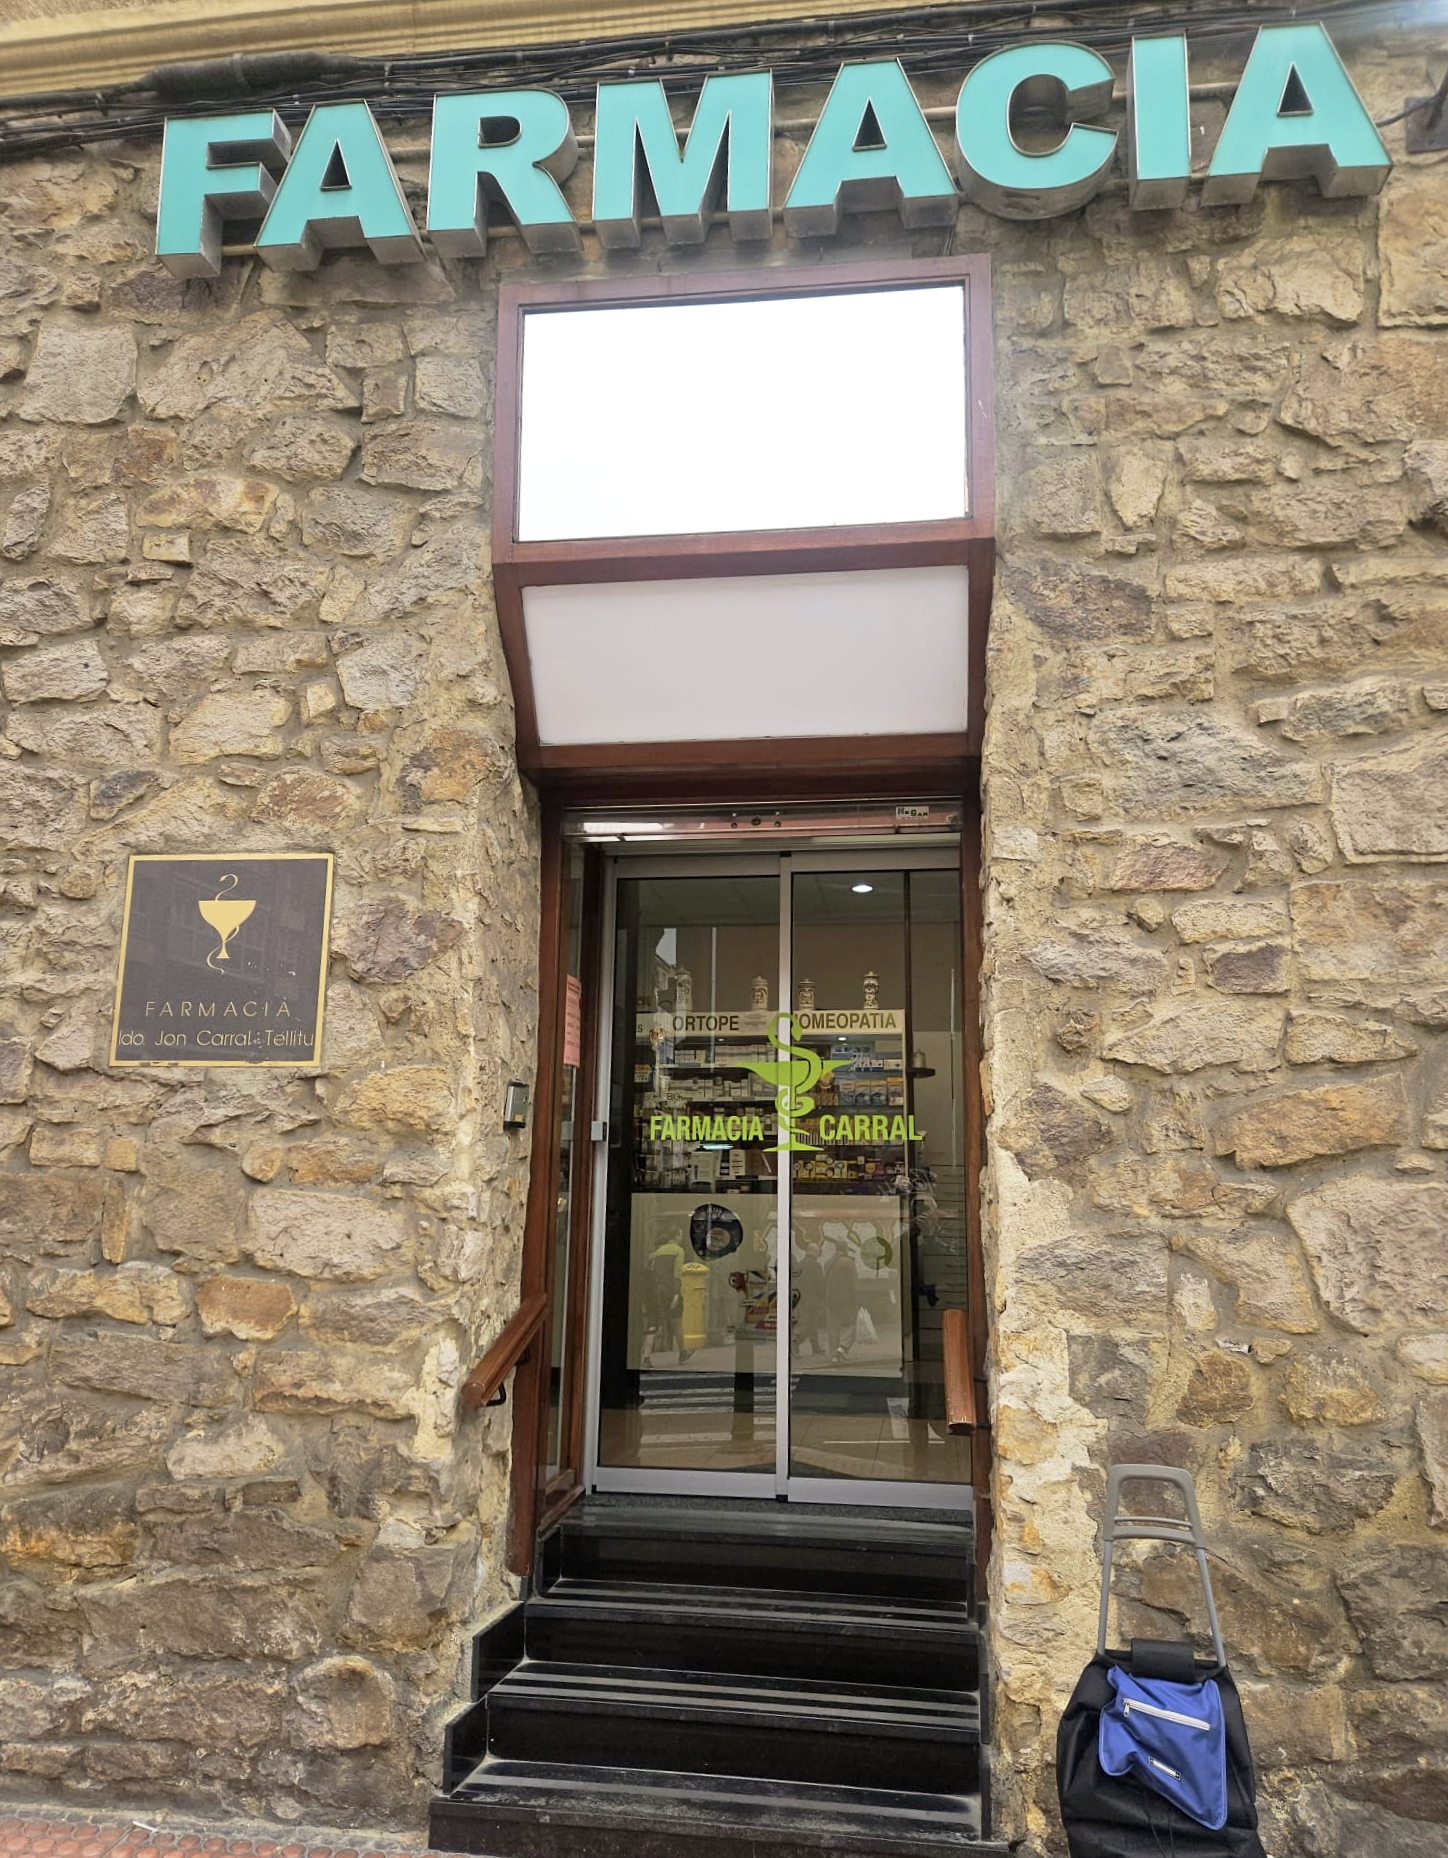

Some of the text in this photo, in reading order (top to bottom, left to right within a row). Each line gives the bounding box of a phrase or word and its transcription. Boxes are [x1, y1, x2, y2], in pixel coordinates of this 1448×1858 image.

[156, 24, 1391, 256] FARMACIA
[145, 1001, 290, 1018] FARMACIA
[794, 1012, 897, 1029] OMEOPATIA
[154, 1030, 186, 1046] Jon
[196, 1029, 252, 1046] Carral
[264, 1029, 314, 1046] Tellitu
[650, 1114, 923, 1141] FARMACIA CARRAL
